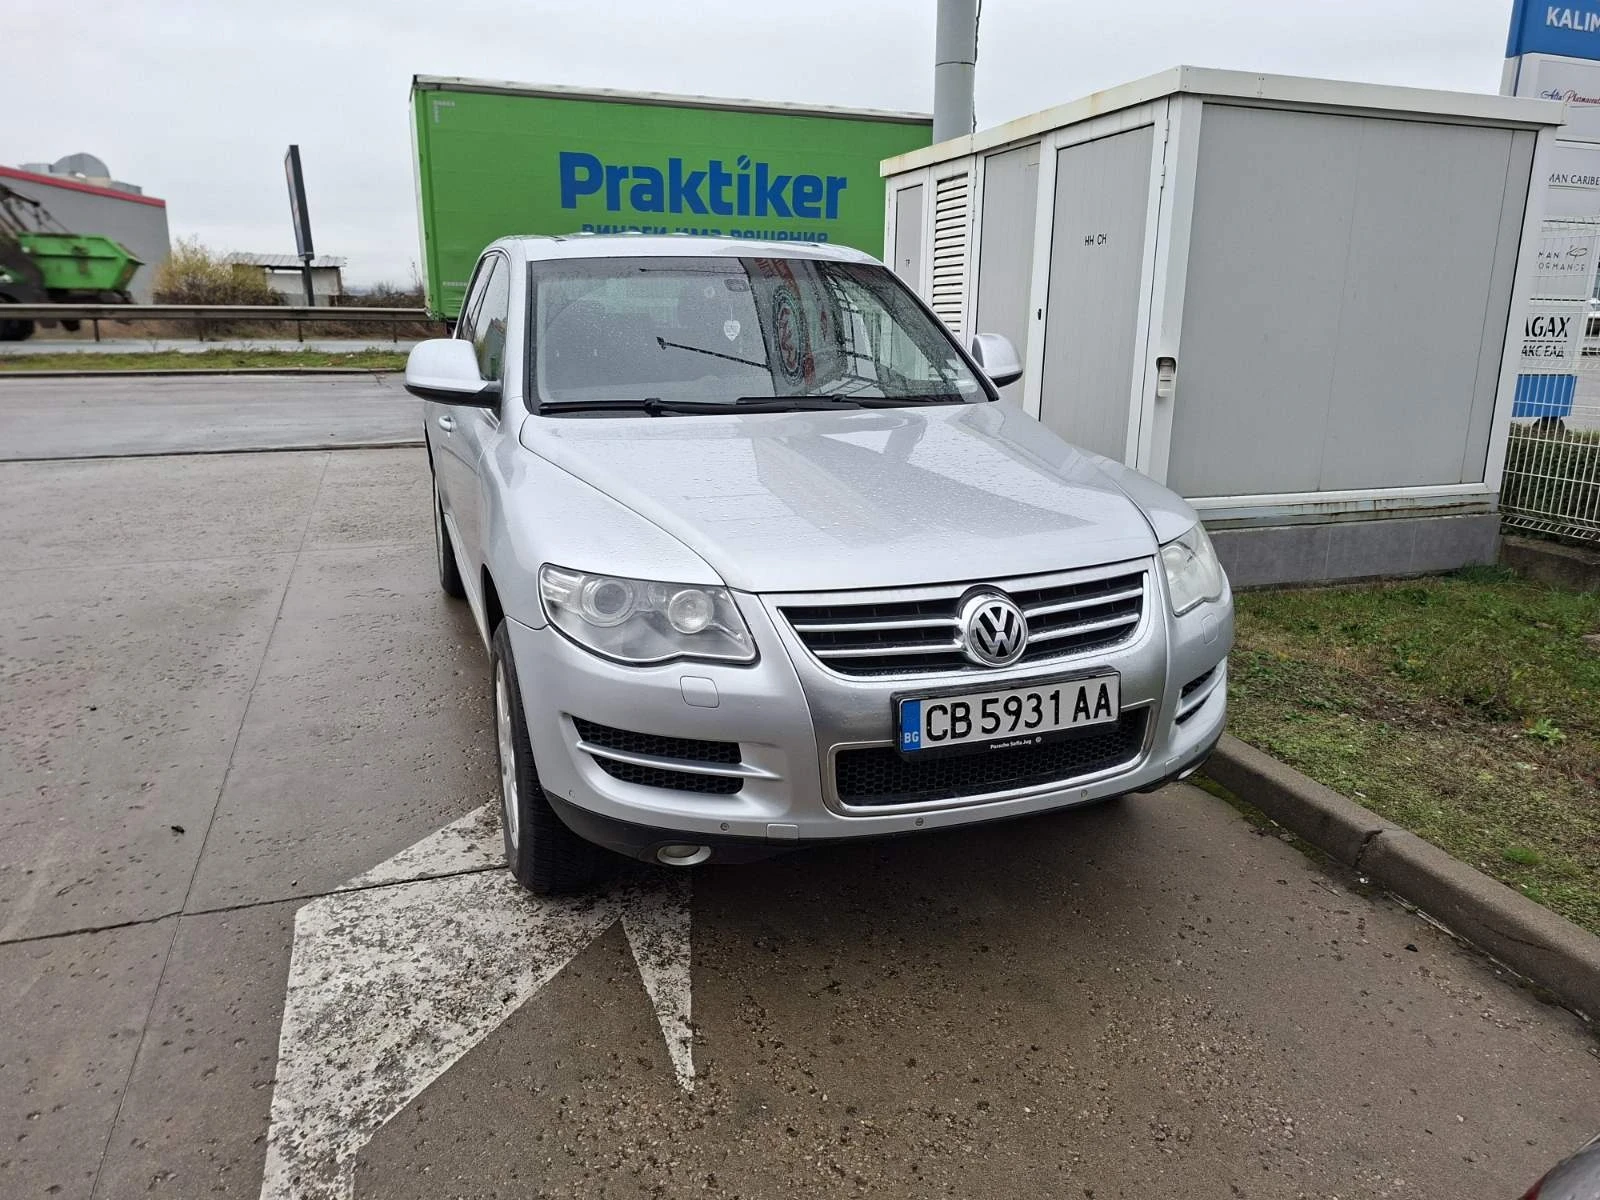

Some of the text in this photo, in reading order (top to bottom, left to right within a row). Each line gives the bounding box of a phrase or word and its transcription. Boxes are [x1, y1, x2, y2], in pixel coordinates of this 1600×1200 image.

[559, 152, 847, 219] Praktiker
[904, 731, 919, 743] BG
[926, 683, 1112, 742] CB 5931 AA
